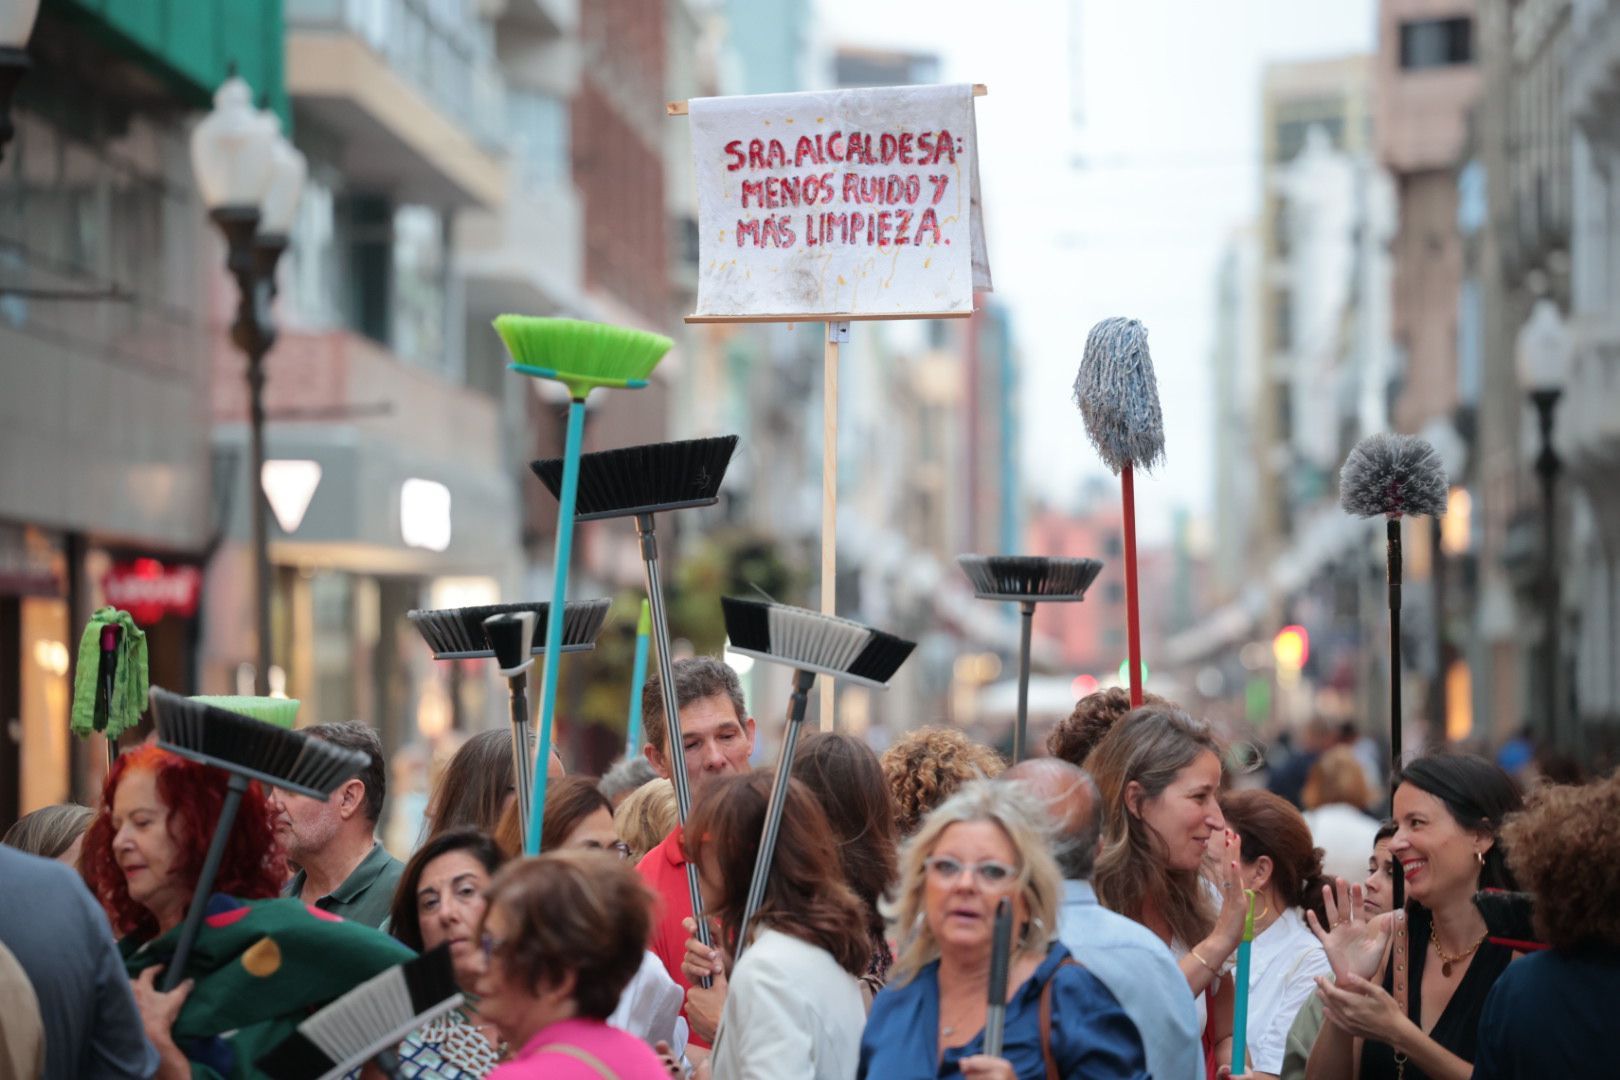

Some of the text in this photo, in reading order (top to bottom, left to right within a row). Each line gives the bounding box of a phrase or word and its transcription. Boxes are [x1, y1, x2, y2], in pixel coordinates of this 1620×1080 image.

[741, 172, 949, 209] MENOS RUIDO Y
[736, 207, 951, 249] MÁS LIMPIEZA.
